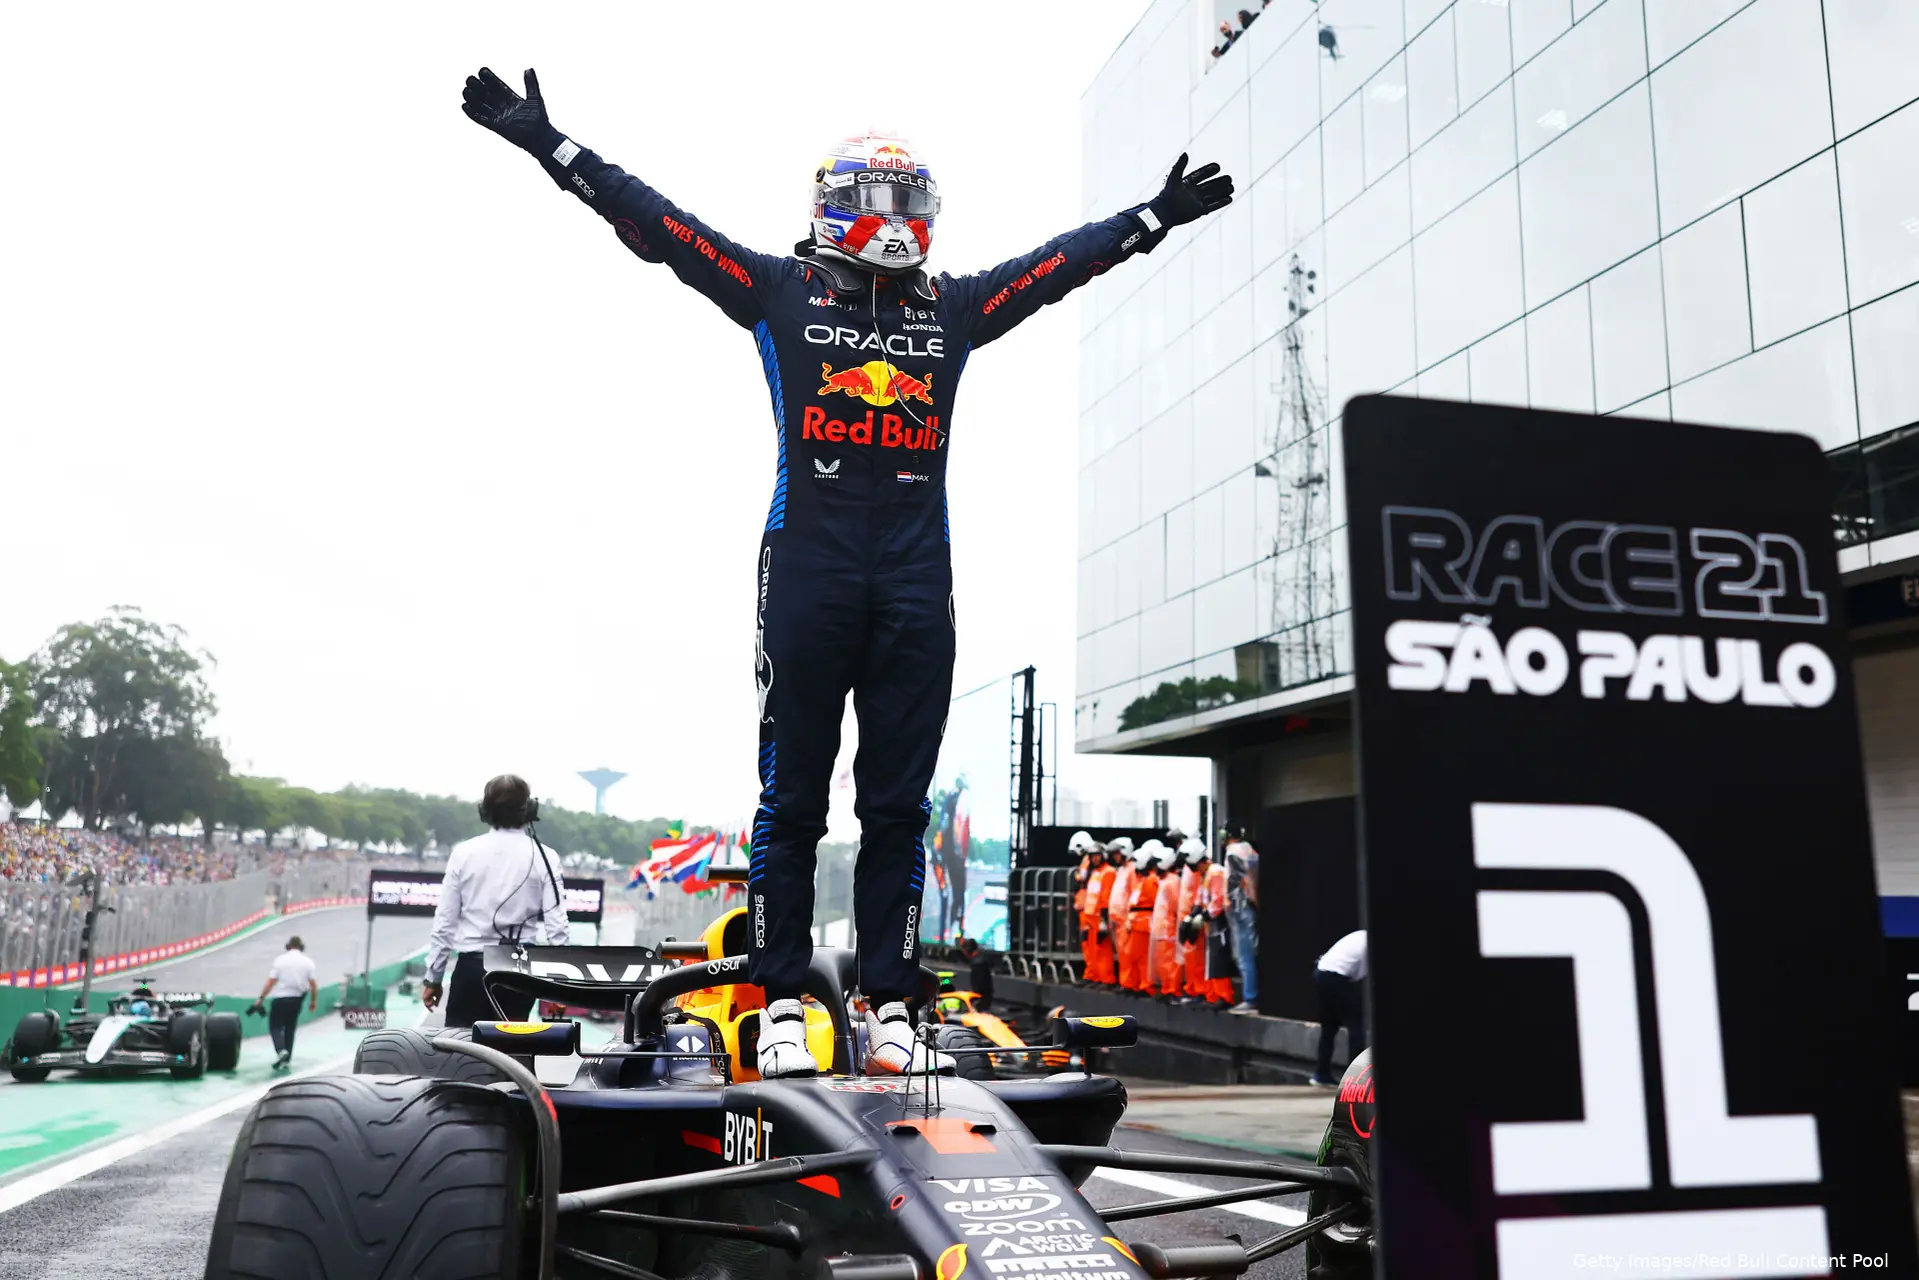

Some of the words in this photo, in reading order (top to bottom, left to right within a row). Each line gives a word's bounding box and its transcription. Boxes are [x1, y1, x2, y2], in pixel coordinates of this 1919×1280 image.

[870, 158, 893, 168] Red
[895, 158, 915, 172] Bull
[571, 172, 595, 198] parco
[857, 172, 926, 188] ORACLE
[663, 215, 694, 243] GIVES
[695, 235, 718, 260] YOU
[717, 253, 753, 288] WINGS
[881, 253, 910, 261] SPORTS
[882, 239, 909, 255] EA
[982, 287, 1010, 315] GIVES
[1010, 274, 1032, 295] YOU
[1032, 252, 1067, 279] WINGS
[904, 306, 936, 321] BYBT
[902, 323, 944, 332] HONDA
[804, 324, 944, 358] ORACLE
[802, 405, 874, 444] Red
[881, 413, 939, 450] Bull
[1382, 505, 1684, 616] RACE
[1690, 527, 1828, 624] 21
[1384, 613, 1569, 696] SÃO
[1576, 629, 1837, 708] PAULO
[754, 894, 765, 949] sparco
[903, 905, 918, 960] sparco
[1470, 802, 1822, 1195] 1
[724, 1106, 773, 1166] BYBIT
[928, 1177, 1049, 1194] VISA
[944, 1196, 1034, 1213] CDW
[1019, 1233, 1096, 1246] ARCTIC
[1032, 1242, 1094, 1254] WOLF
[985, 1254, 1117, 1273] PIRELLI
